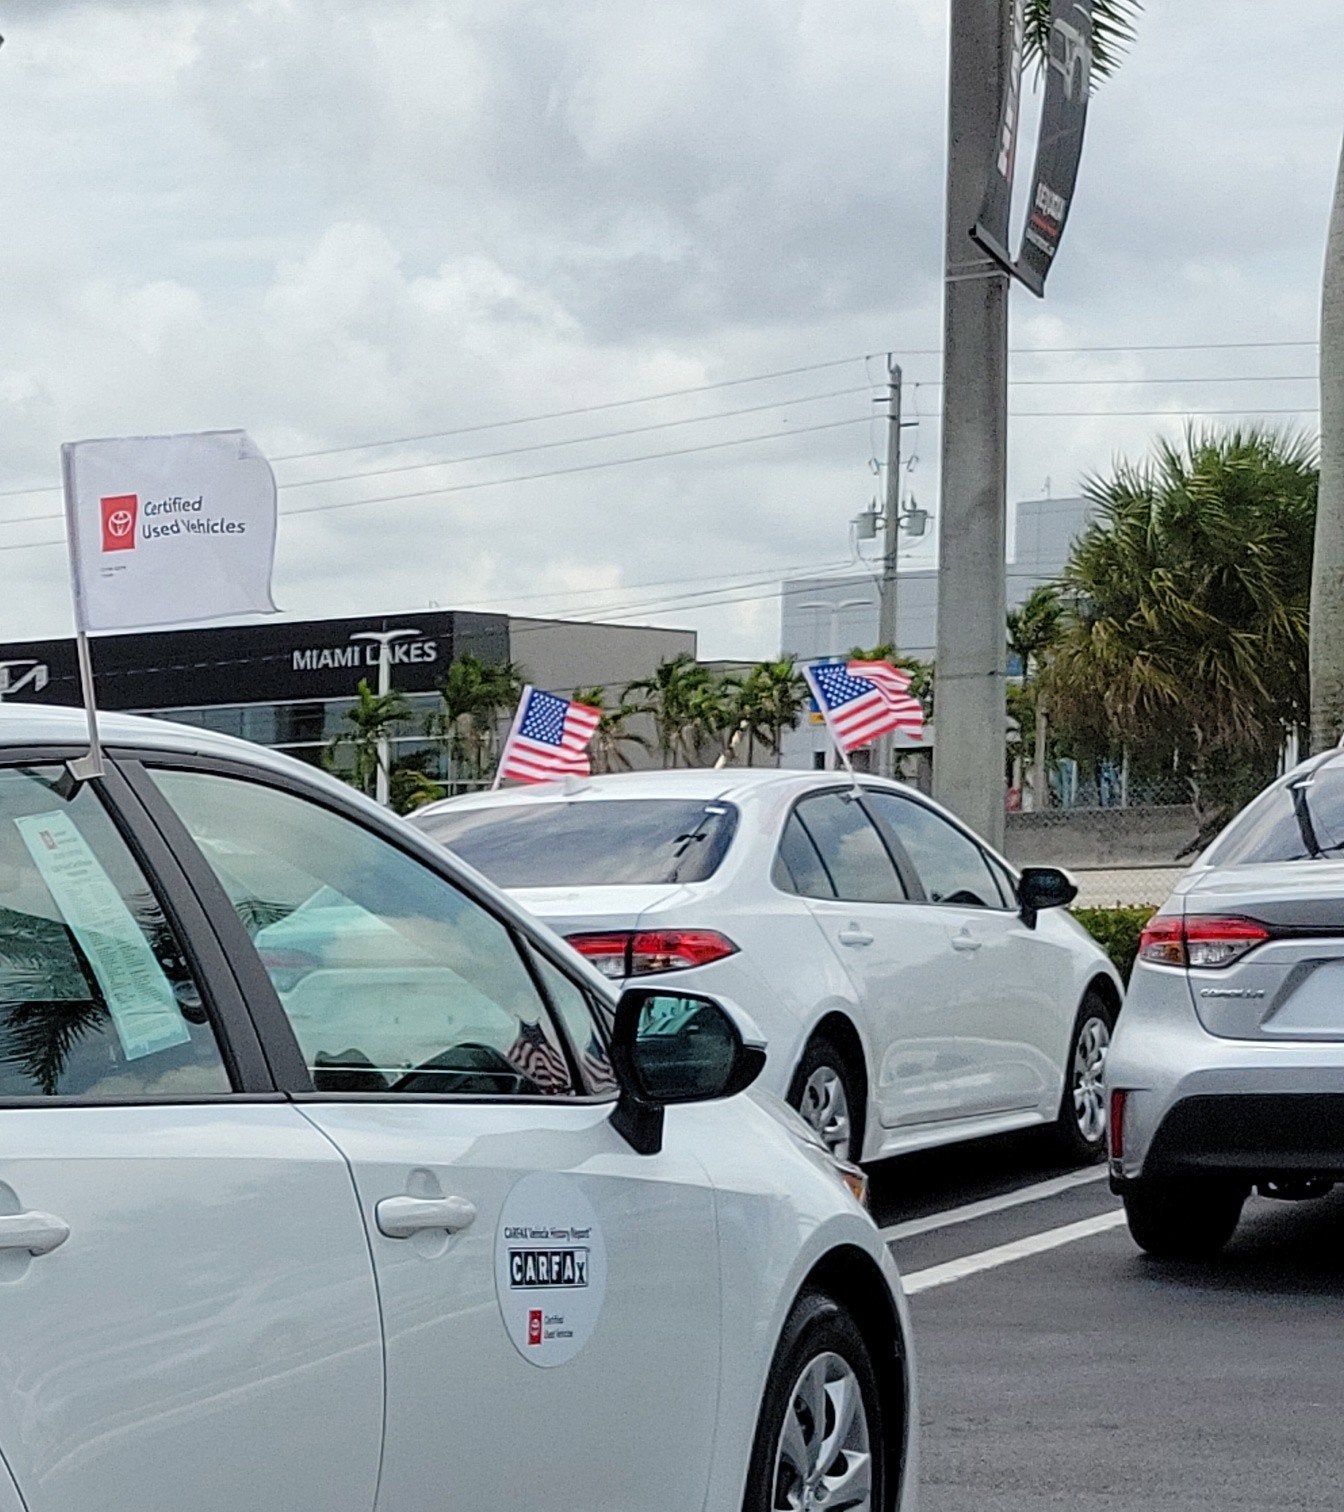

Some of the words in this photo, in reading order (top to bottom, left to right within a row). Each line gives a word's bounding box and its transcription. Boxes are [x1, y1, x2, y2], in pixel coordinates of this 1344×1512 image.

[143, 496, 203, 517] Certified
[142, 519, 181, 539] Used
[183, 517, 246, 534] Vehicles
[292, 646, 360, 671] MIAMI
[512, 1254, 587, 1284] CARFAX
